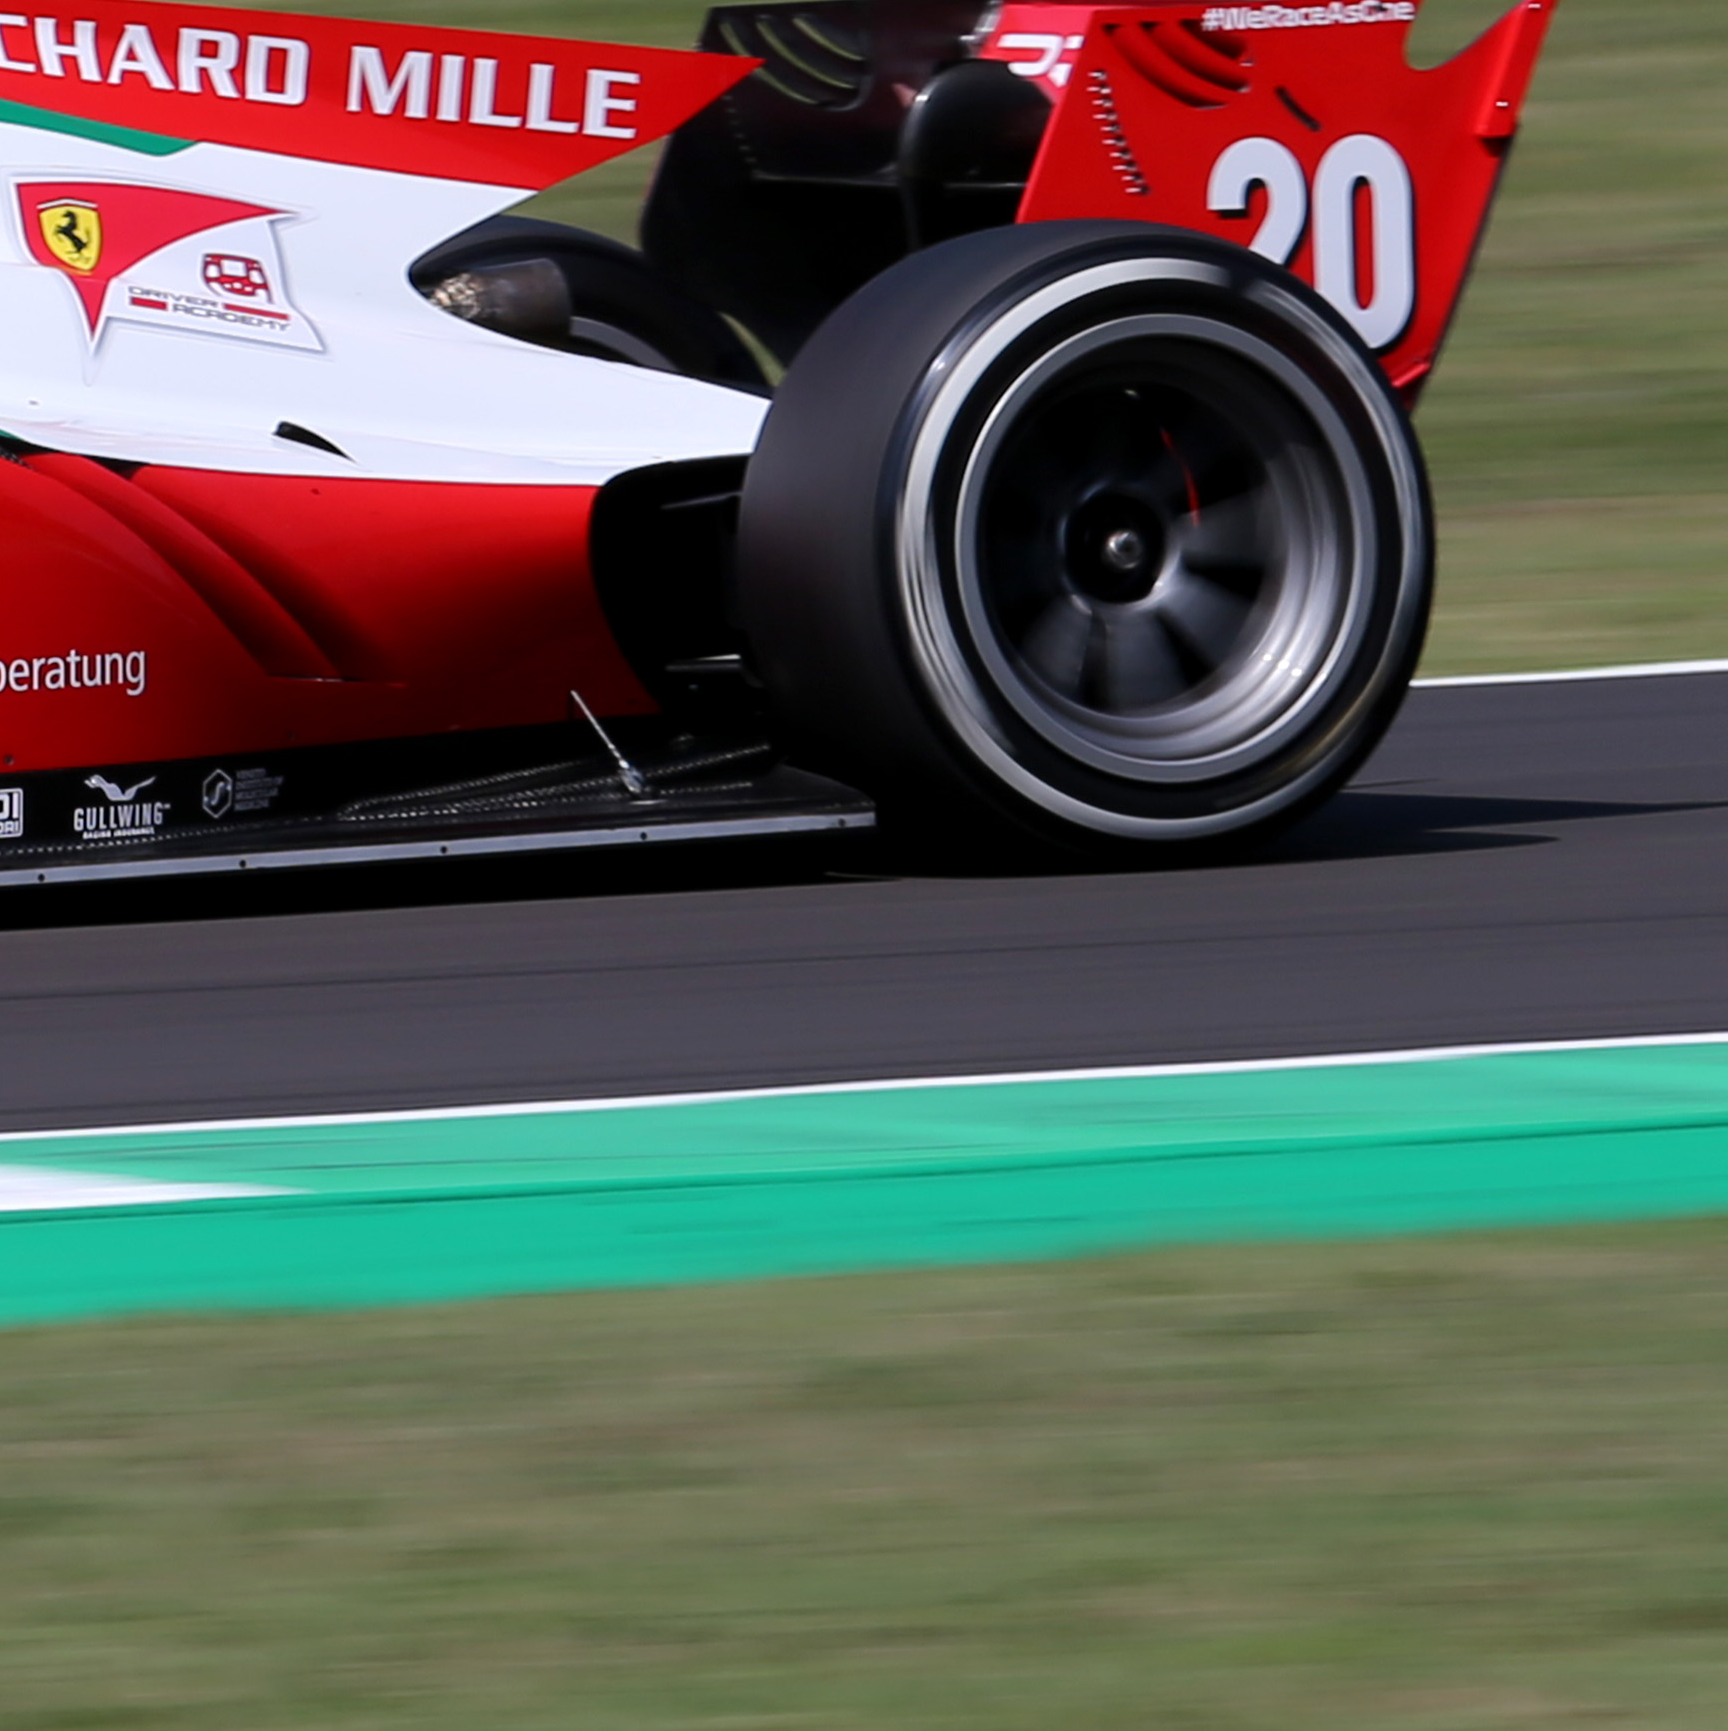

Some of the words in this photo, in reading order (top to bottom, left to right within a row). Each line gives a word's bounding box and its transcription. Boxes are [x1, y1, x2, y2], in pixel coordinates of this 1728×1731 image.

[346, 46, 641, 139] MILLE
[1207, 133, 1415, 349] 20
[128, 286, 218, 308] DRIVER
[171, 304, 290, 332] ACADEMY
[74, 802, 163, 832] GULLWING
